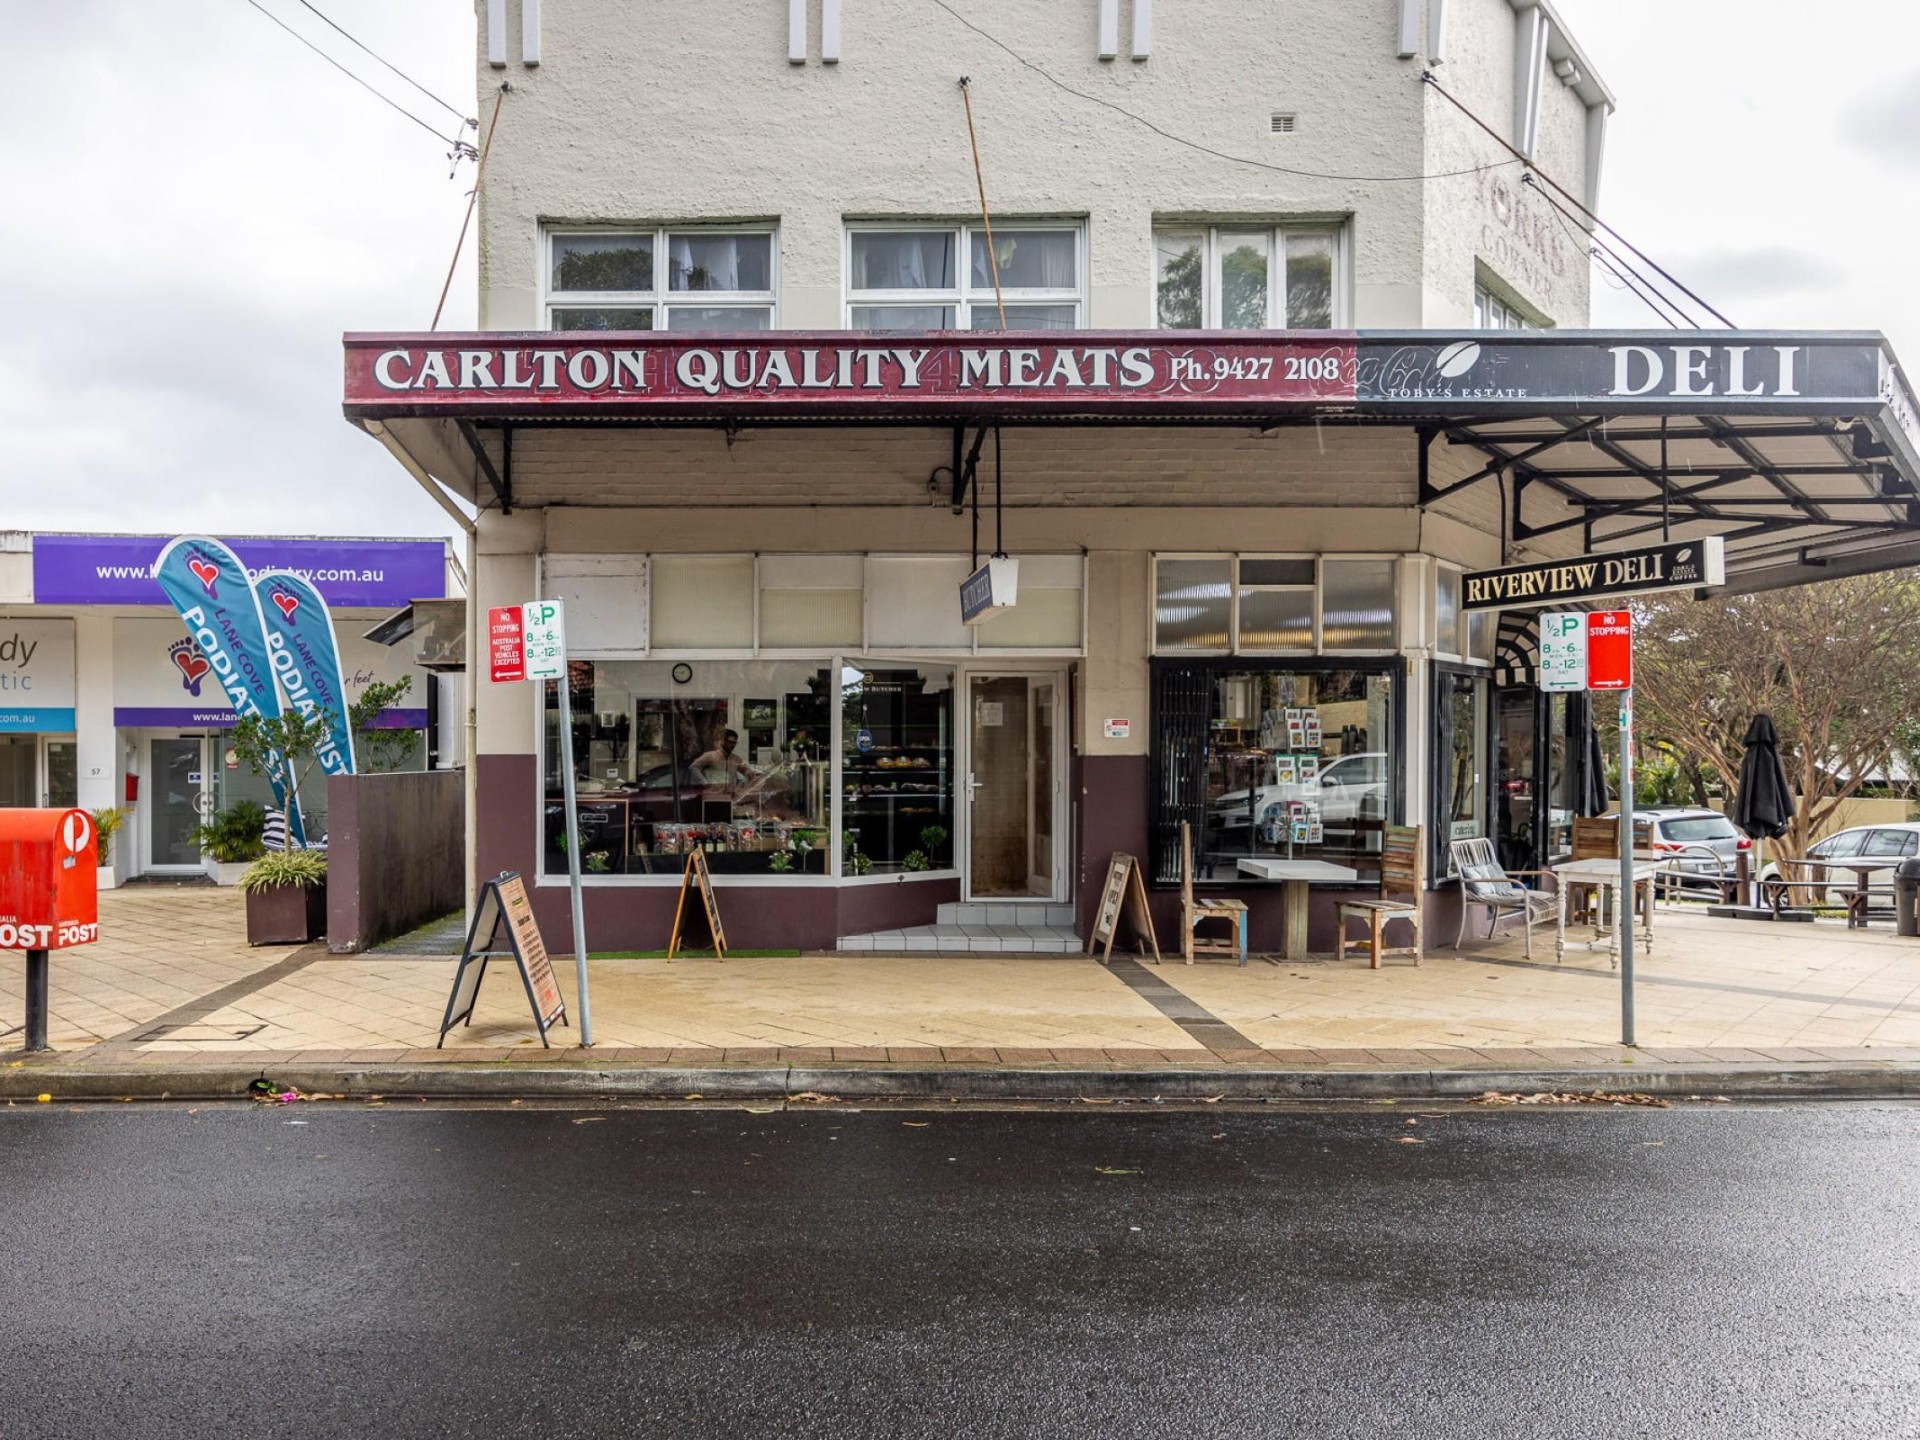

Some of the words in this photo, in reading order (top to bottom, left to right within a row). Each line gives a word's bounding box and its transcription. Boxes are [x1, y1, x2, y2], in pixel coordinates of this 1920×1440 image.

[374, 349, 648, 390] CARLTON
[675, 349, 931, 395] QUALITY
[959, 348, 1156, 388] MEATS
[1284, 357, 1339, 380] 2108
[1608, 346, 1801, 396] DELI
[1388, 388, 1453, 398] TOBY'S
[1462, 388, 1528, 398] ESTATE
[1467, 562, 1598, 602] RIVERVIEW
[1602, 553, 1664, 586] DELI
[500, 613, 511, 622] NO
[1603, 615, 1616, 625] NO
[492, 624, 519, 634] STOPPING
[1589, 626, 1629, 636] STOPPING
[492, 637, 520, 645] AUSTRALIA
[214, 608, 243, 652] LANE
[237, 651, 266, 697] COVE
[494, 650, 519, 659] VEHICLES
[494, 658, 520, 666] EXCEPTED
[292, 633, 317, 671] LANE
[310, 670, 335, 705] COVE
[353, 669, 375, 688] feet
[91, 768, 101, 776] 57
[58, 923, 97, 946] POST
